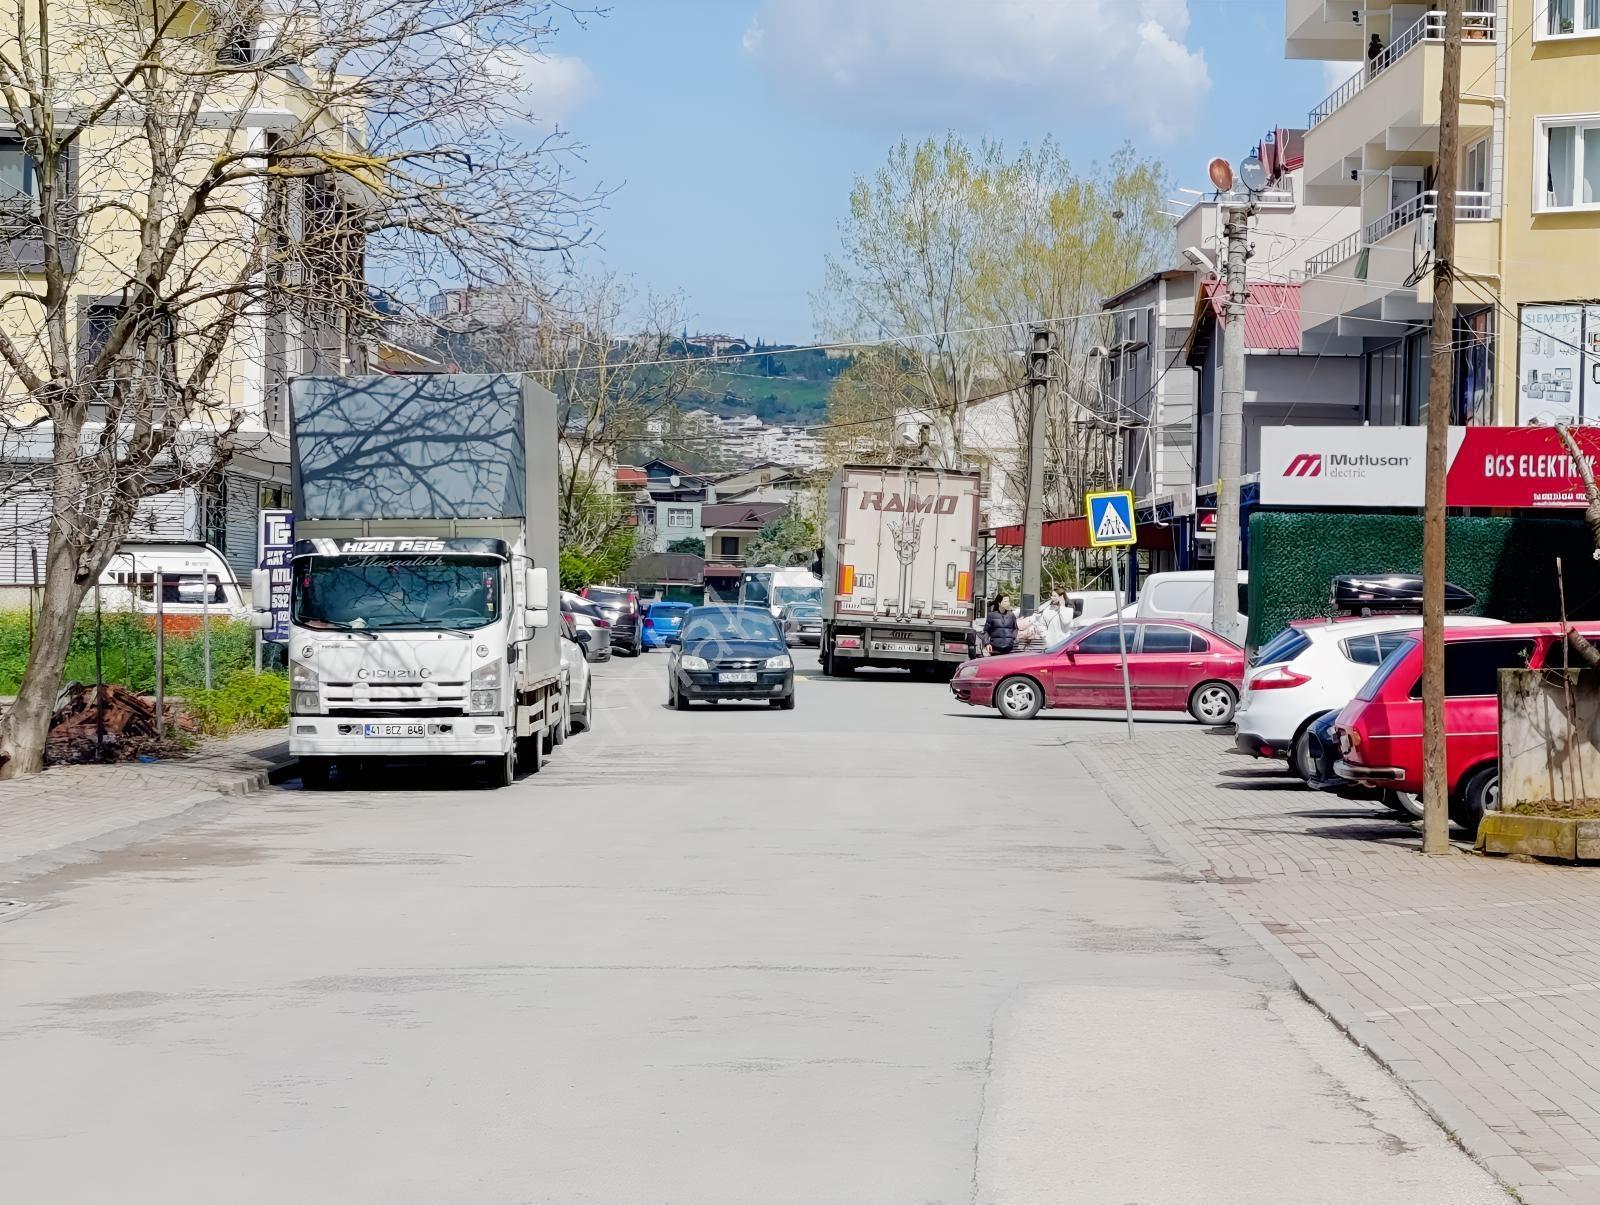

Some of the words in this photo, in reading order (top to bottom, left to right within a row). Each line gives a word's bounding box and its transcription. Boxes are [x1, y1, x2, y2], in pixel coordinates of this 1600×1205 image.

[1525, 313, 1577, 324] SIEMENS
[1330, 454, 1409, 466] Mutlusan
[1485, 454, 1515, 478] BGS
[1519, 454, 1595, 478] ELEKTRK
[1330, 468, 1366, 478] electric
[859, 491, 959, 515] RAMO
[855, 574, 873, 587] TIR
[372, 669, 417, 678] ISUZU
